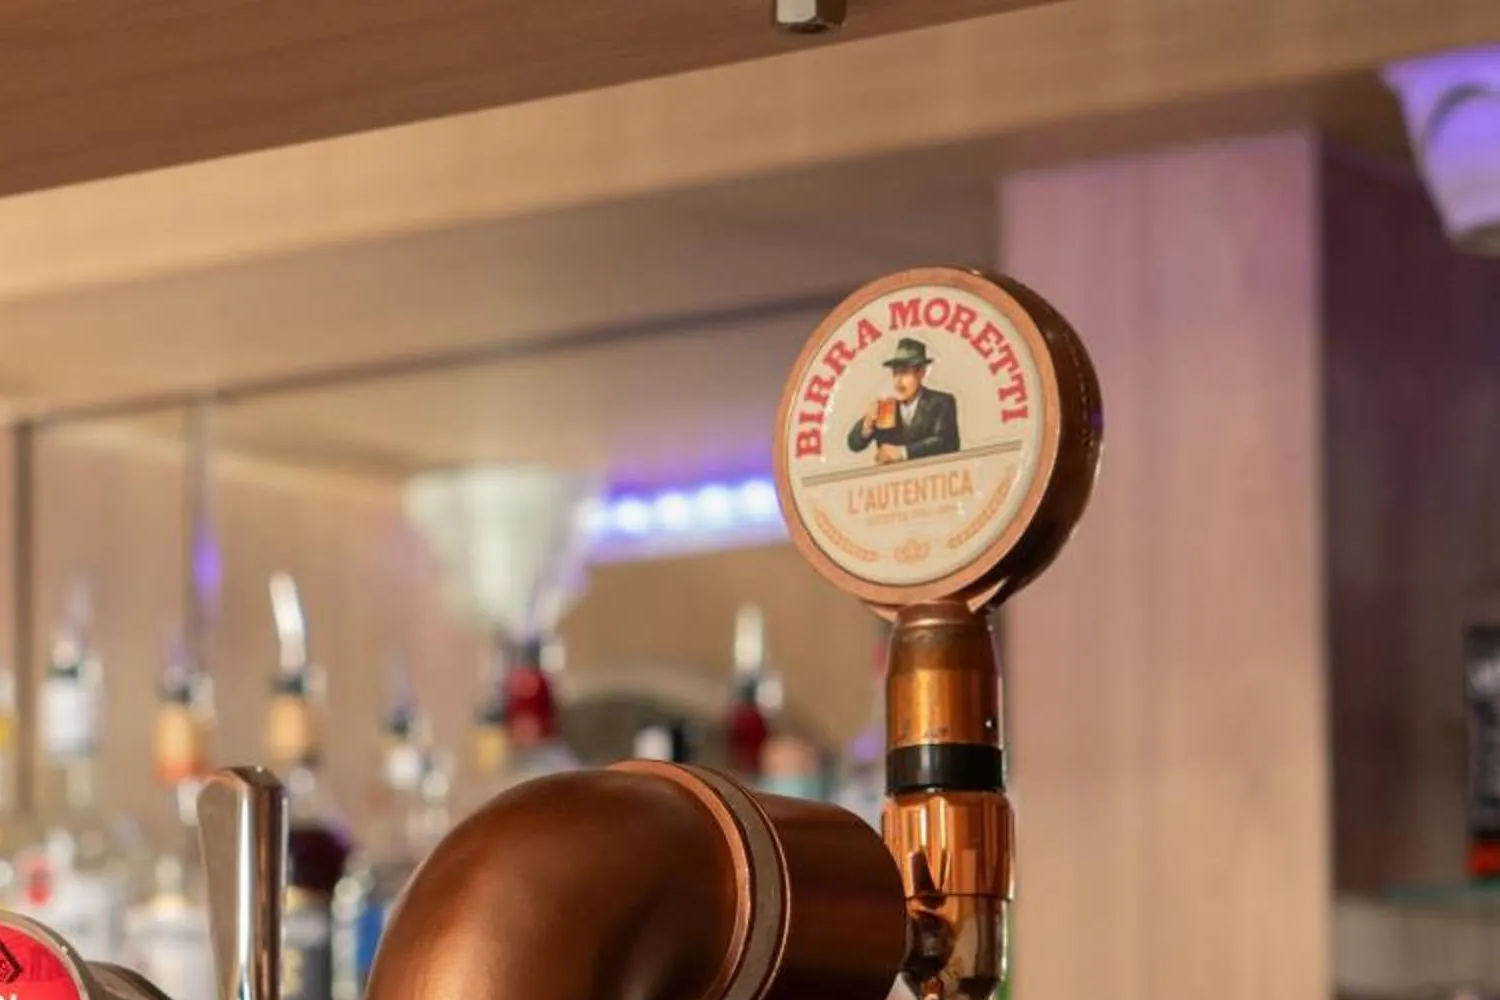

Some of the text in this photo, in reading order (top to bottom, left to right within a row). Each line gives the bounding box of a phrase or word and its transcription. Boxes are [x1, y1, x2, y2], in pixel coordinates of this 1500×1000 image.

[795, 297, 1030, 459] BIRRA MORETTI
[847, 469, 975, 516] L'AUTENTICA
